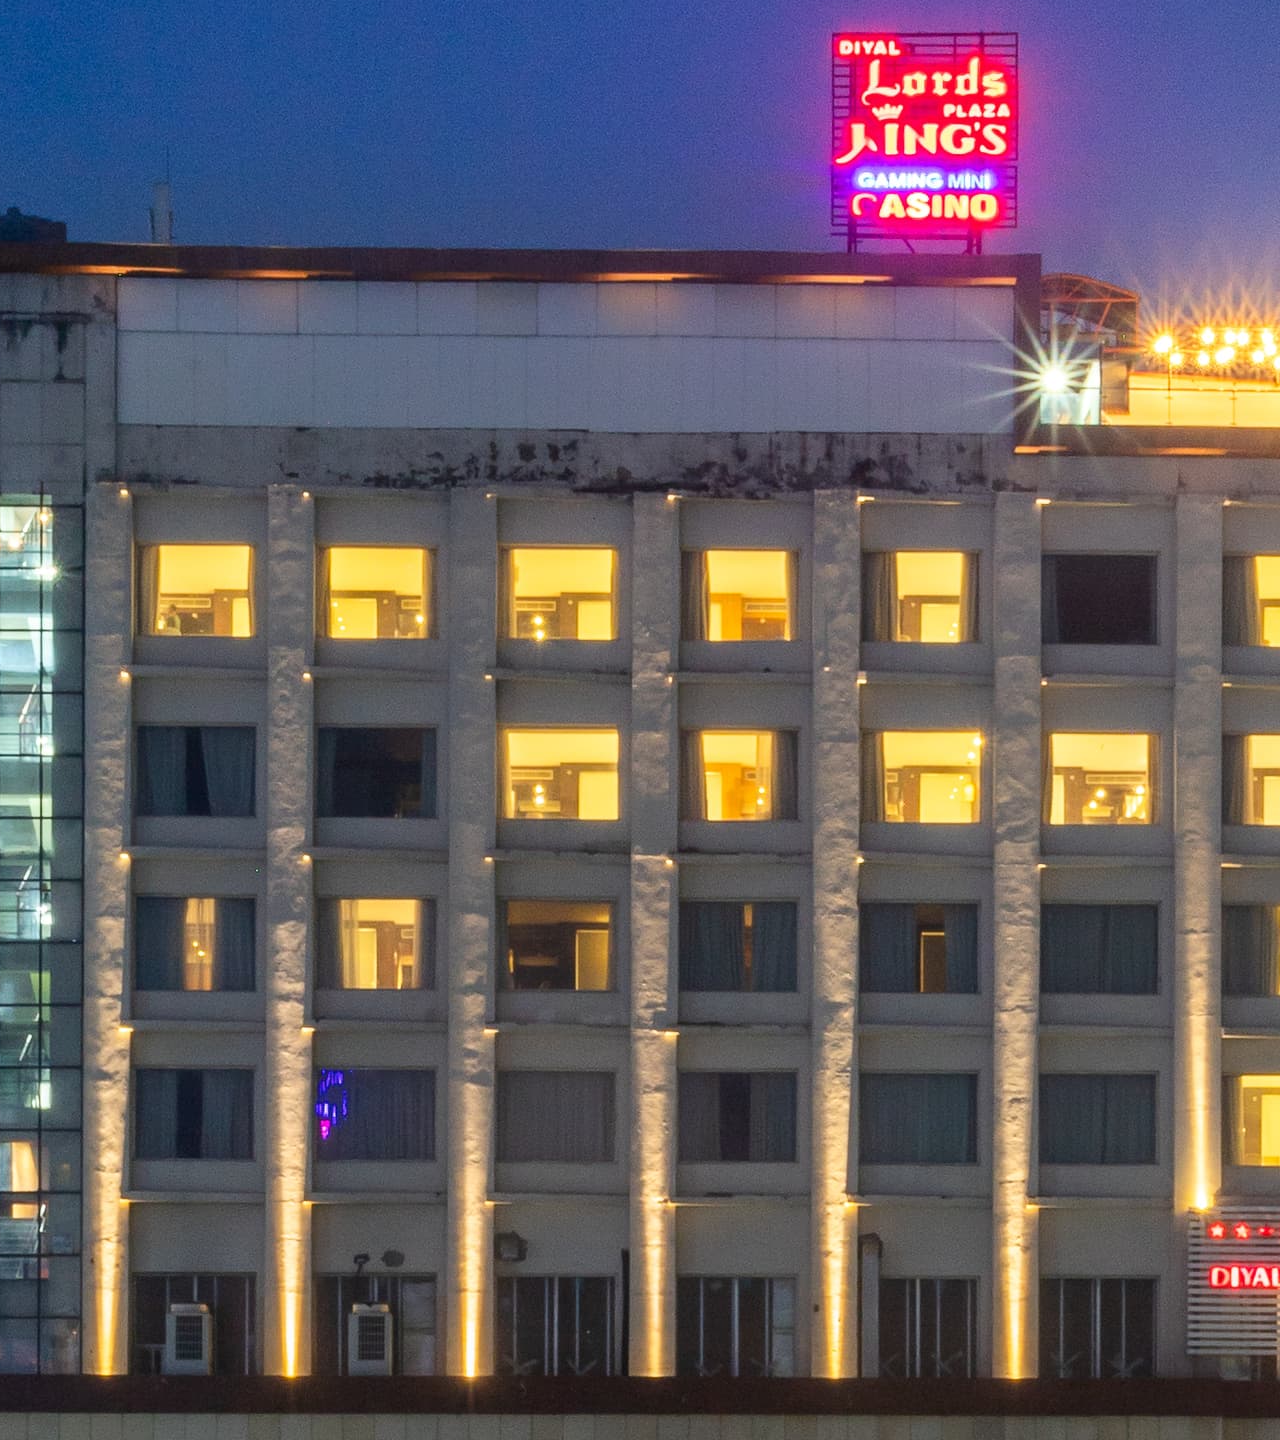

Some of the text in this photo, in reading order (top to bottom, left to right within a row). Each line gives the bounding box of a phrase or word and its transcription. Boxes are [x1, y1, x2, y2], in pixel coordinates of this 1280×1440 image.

[861, 57, 1007, 105] Lords
[943, 103, 1011, 118] PLAZA
[857, 172, 992, 189] GAMING MINI
[852, 192, 998, 220] CASINO
